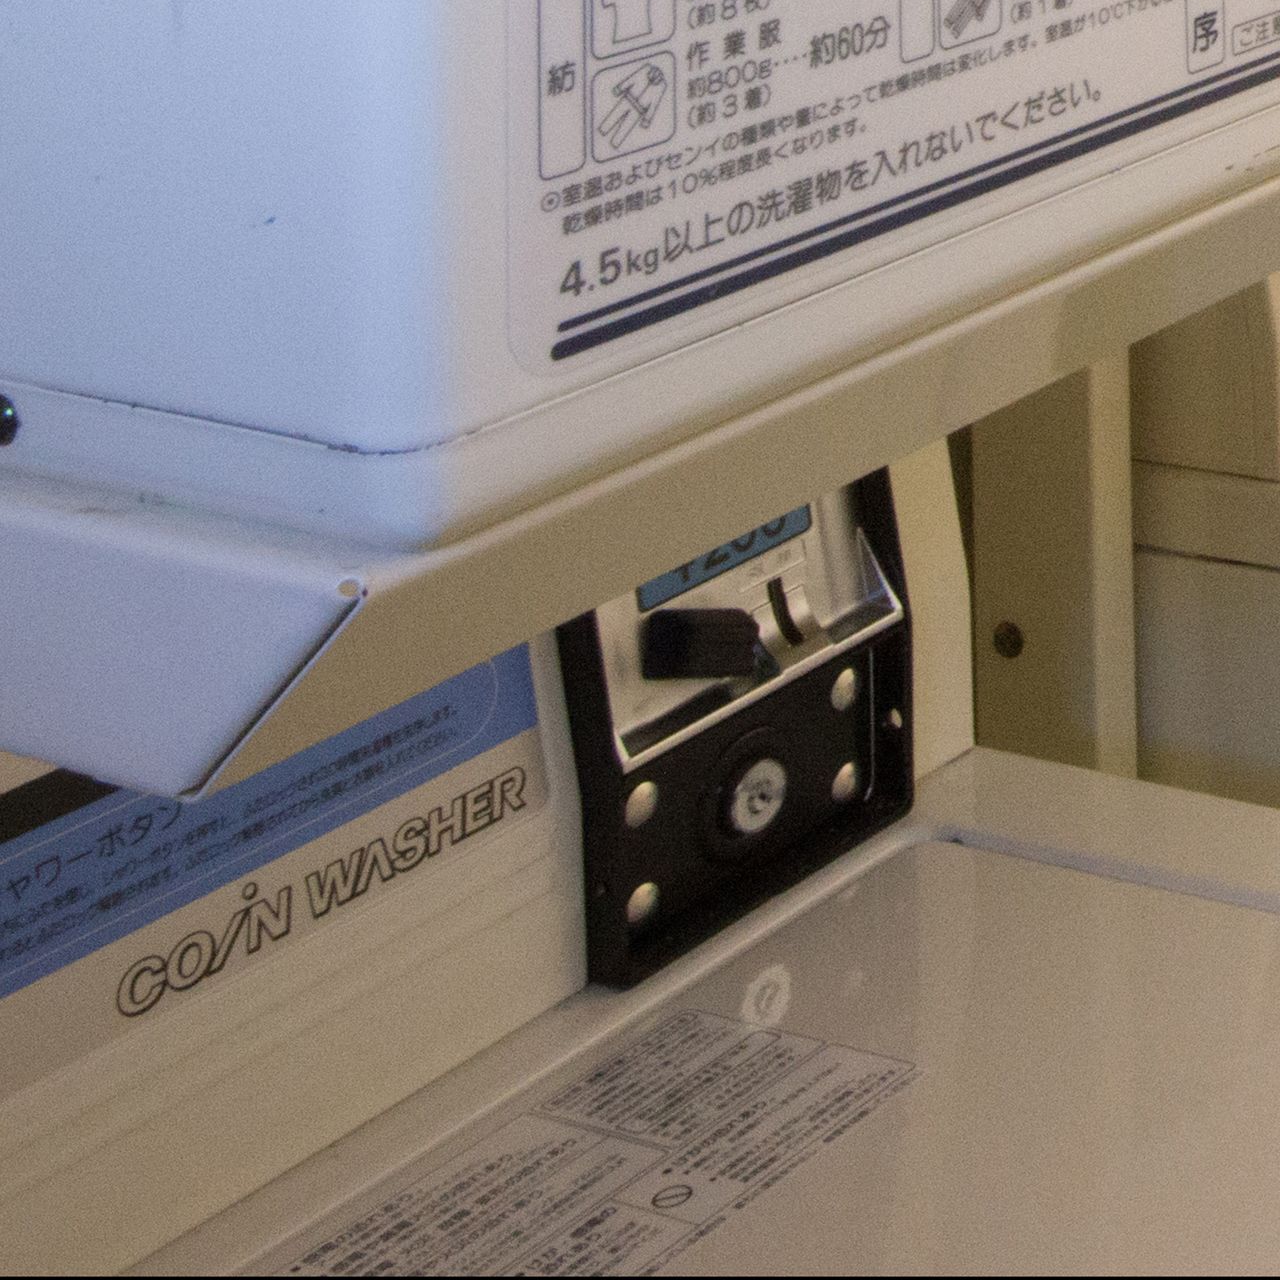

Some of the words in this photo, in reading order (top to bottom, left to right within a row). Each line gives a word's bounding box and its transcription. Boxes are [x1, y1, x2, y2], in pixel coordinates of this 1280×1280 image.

[808, 14, 891, 70] 約60分
[559, 79, 1102, 297] 4.5kg以上の洗濯物を入れないでください。
[305, 766, 527, 919] WASHER
